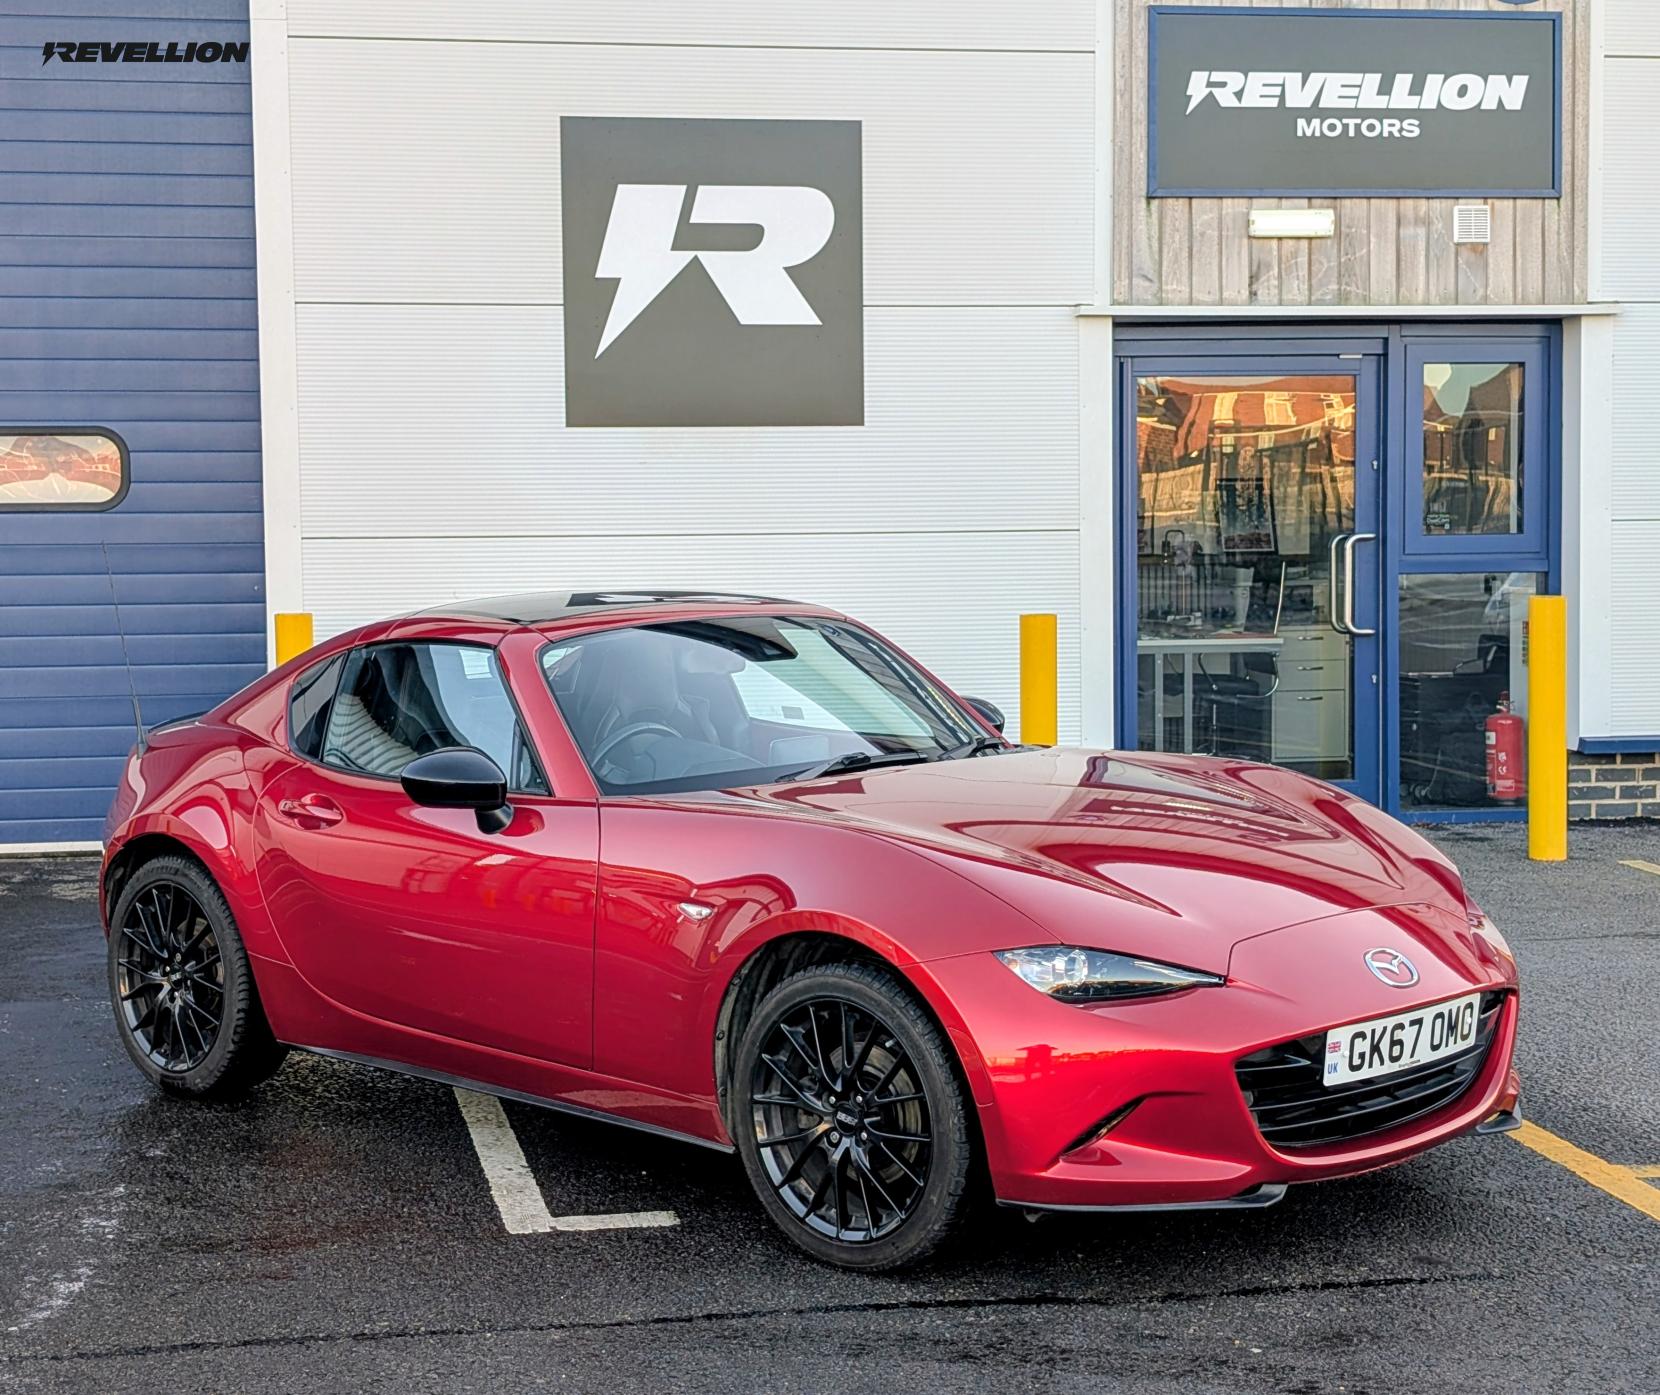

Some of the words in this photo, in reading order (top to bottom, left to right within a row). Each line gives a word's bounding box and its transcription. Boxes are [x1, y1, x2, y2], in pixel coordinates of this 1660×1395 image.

[1186, 71, 1530, 115] REVELLION
[1296, 118, 1420, 137] MOTORS
[1348, 1017, 1424, 1072] GK67
[1327, 1062, 1339, 1075] UK
